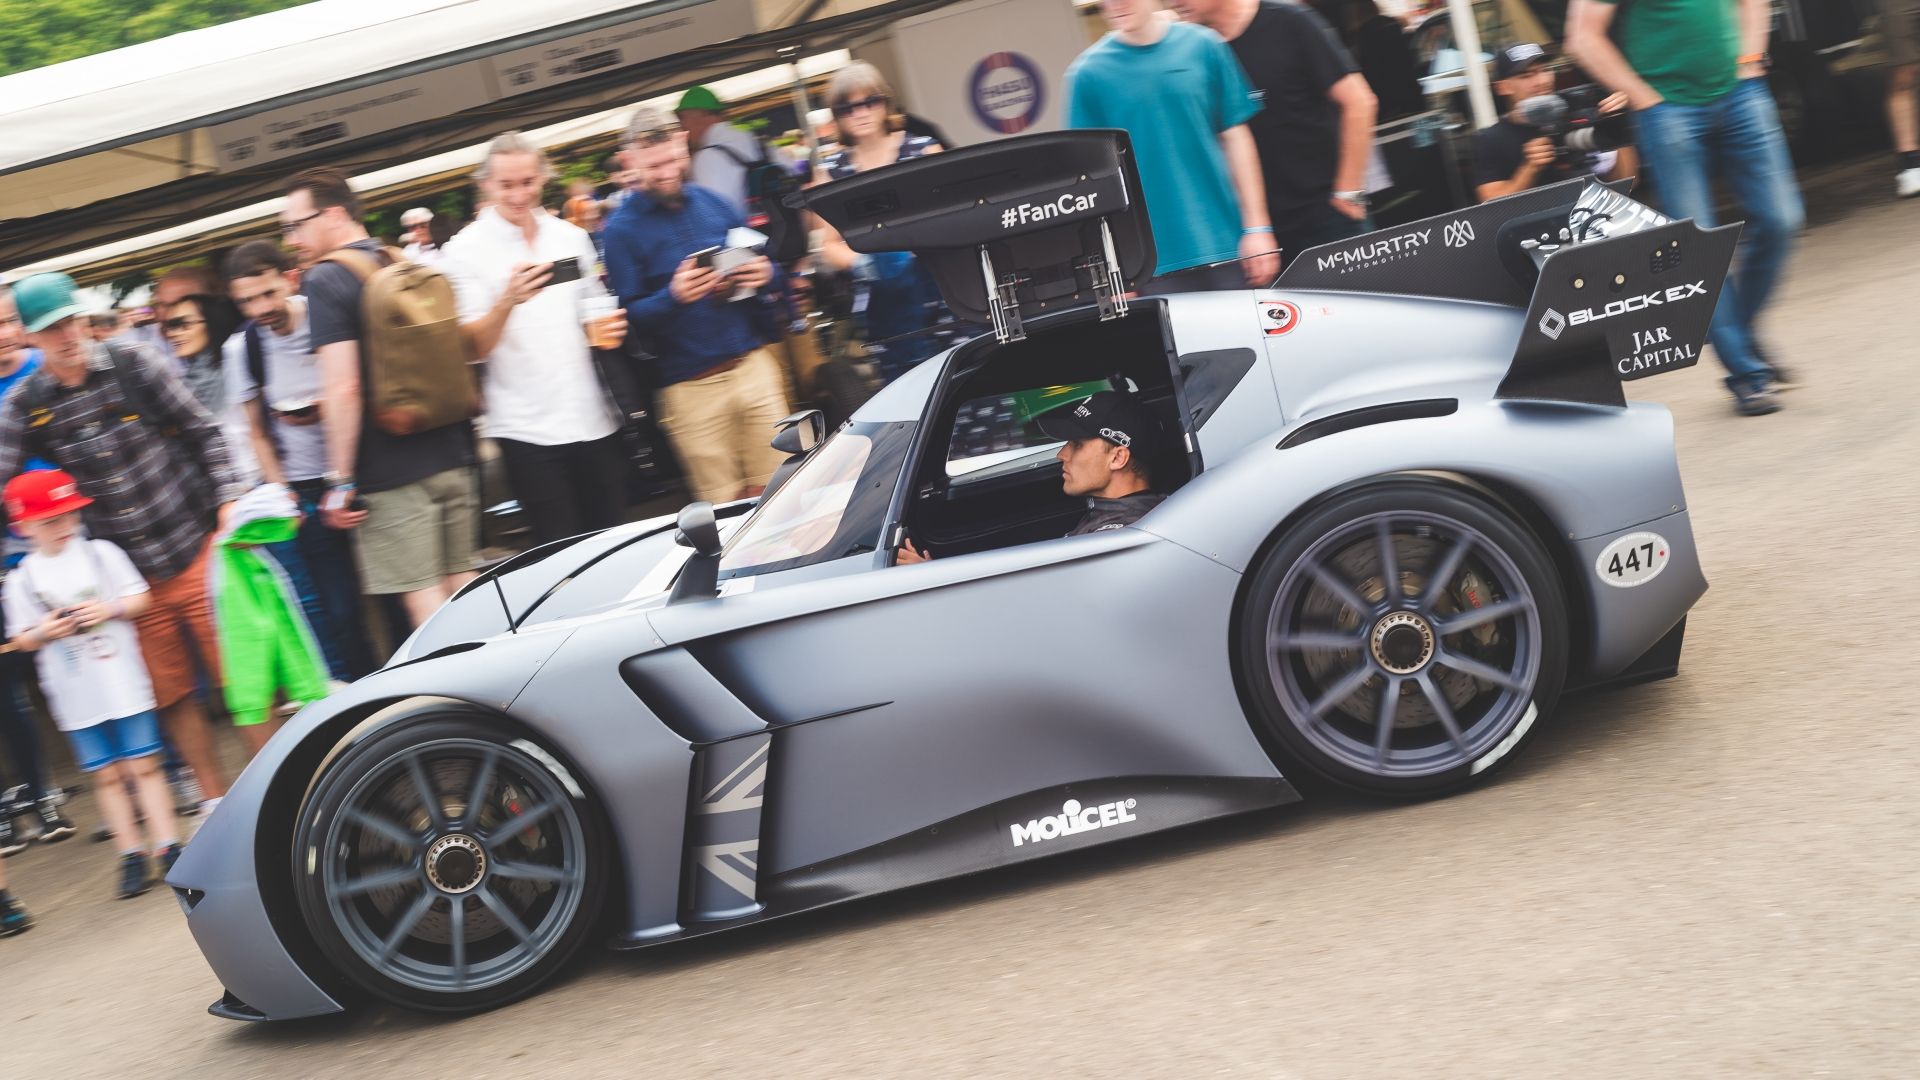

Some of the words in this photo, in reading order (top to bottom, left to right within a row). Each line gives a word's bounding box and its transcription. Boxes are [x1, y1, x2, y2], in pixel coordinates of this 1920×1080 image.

[1001, 192, 1097, 228] #FanCar
[1340, 249, 1418, 274] AUTOMOTIVE
[1632, 326, 1671, 354] JAR
[1617, 343, 1696, 374] CAPITAL
[1608, 542, 1654, 577] 447
